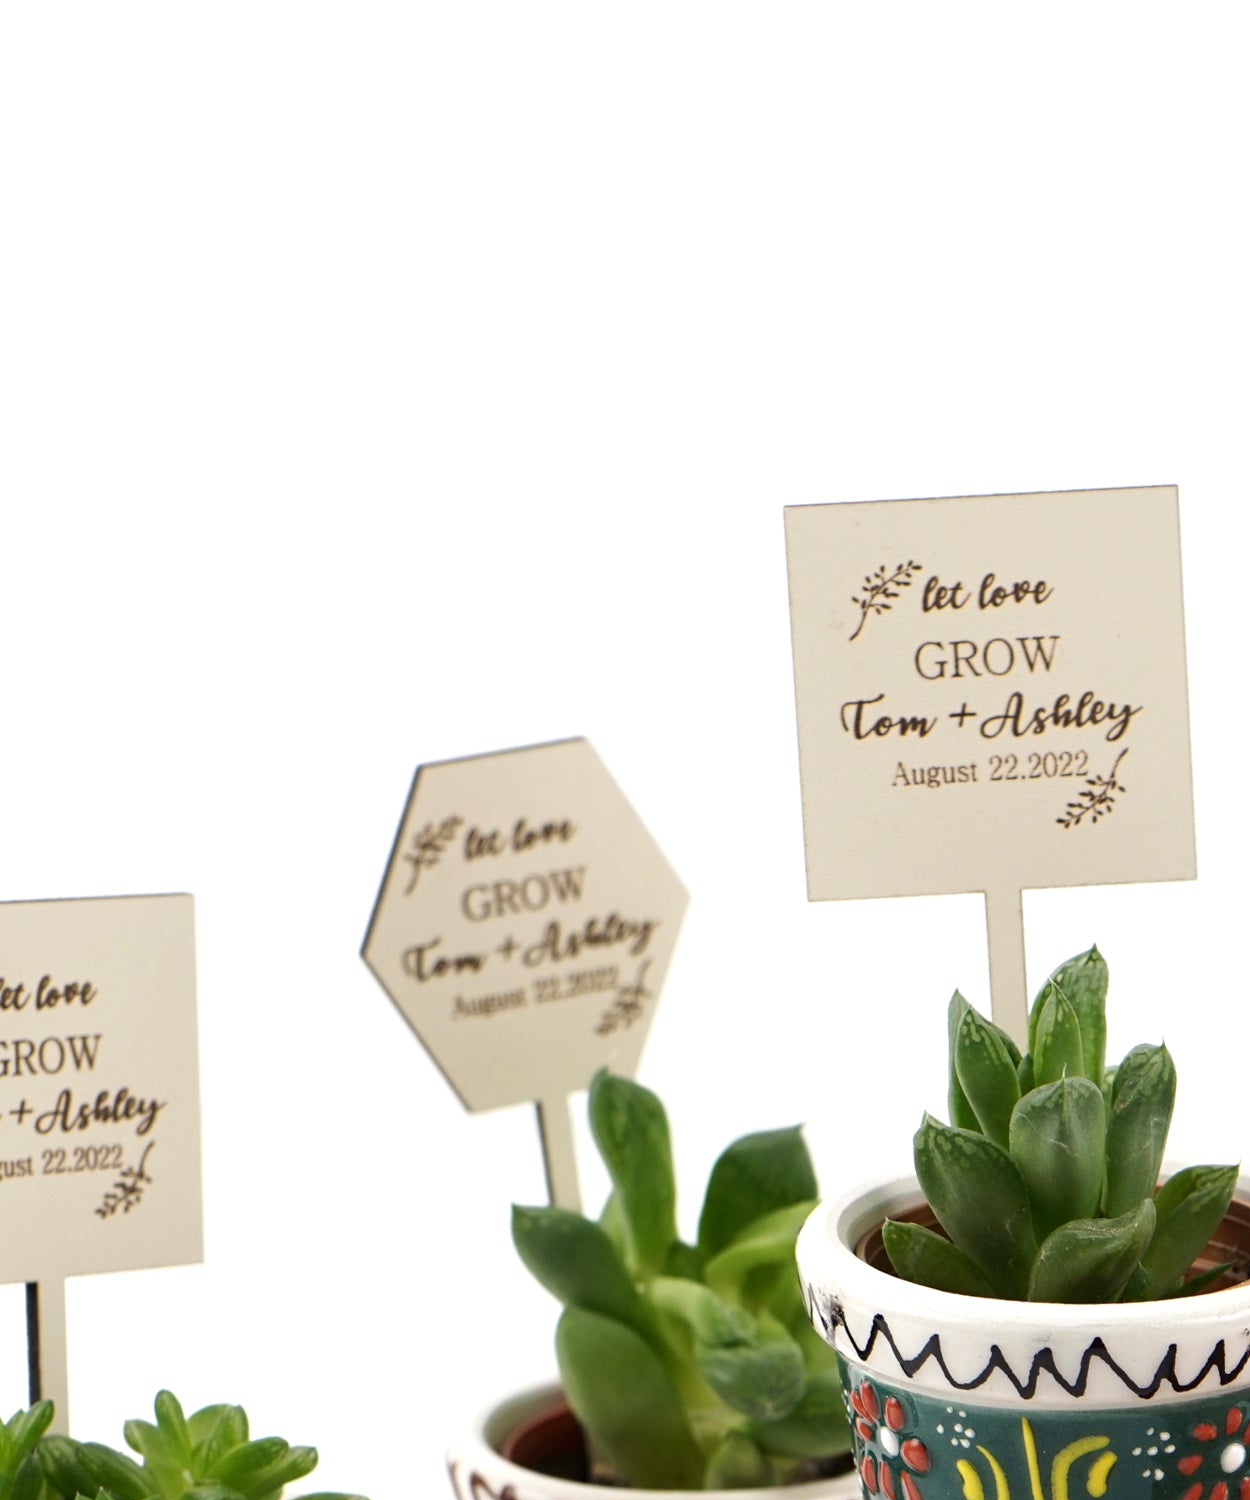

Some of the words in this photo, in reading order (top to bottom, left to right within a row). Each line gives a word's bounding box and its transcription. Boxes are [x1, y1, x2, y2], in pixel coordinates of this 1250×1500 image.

[922, 576, 971, 613] let
[978, 573, 1054, 610] love
[914, 636, 1060, 680] GROW
[841, 694, 937, 740] Tom
[892, 760, 978, 789] August
[989, 750, 1089, 782] 22.2022
[463, 826, 505, 862] let
[510, 818, 576, 854] love
[460, 866, 587, 923] GROW
[402, 936, 487, 984] Tom
[35, 974, 97, 1011] love
[453, 986, 527, 1019] August
[41, 1143, 123, 1175] 22.2022
